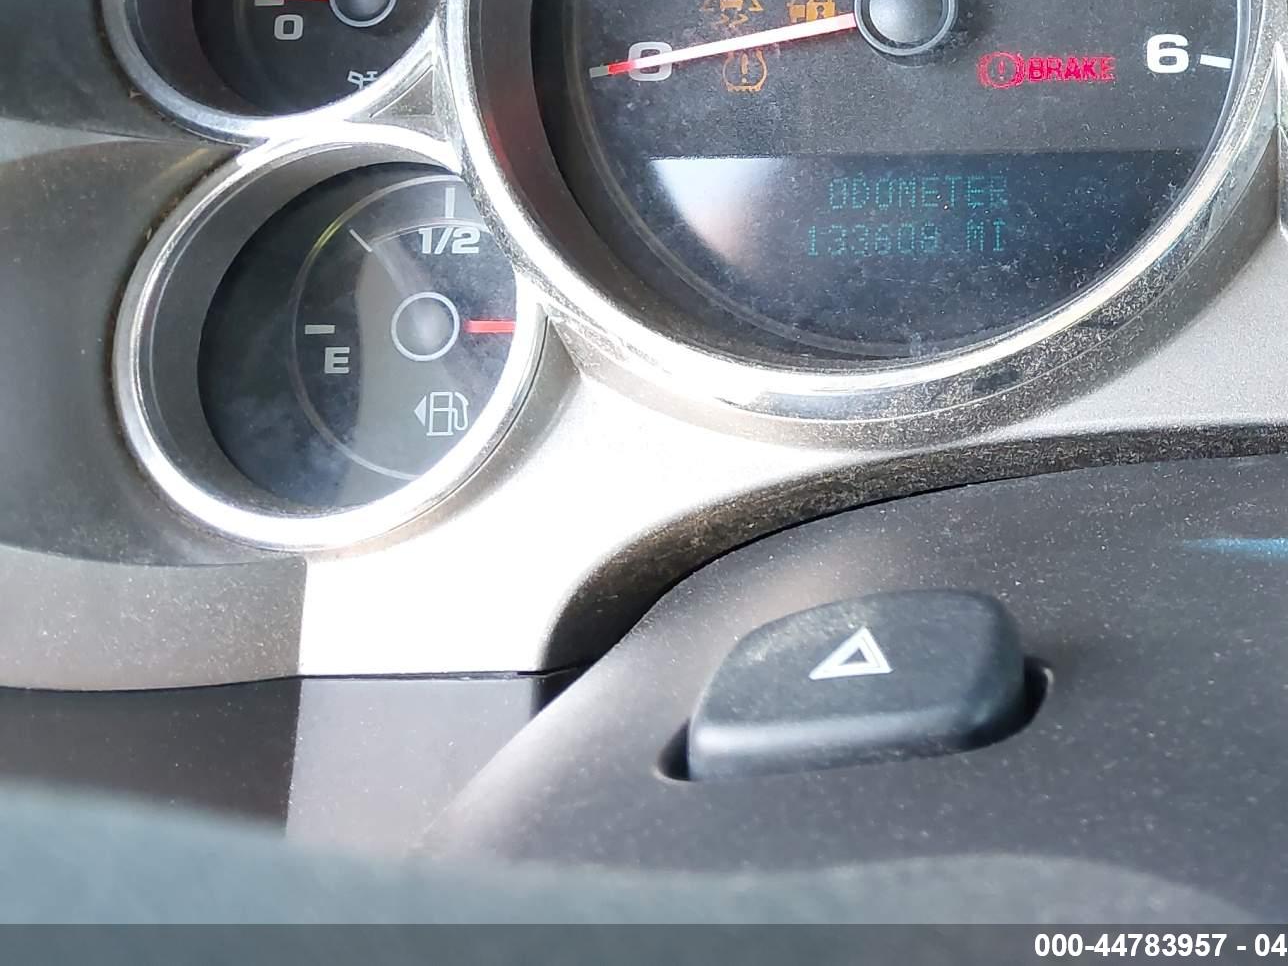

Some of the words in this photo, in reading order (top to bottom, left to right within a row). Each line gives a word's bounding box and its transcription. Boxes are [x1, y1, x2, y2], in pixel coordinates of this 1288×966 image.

[273, 13, 304, 41] 0
[627, 40, 674, 82] 0
[1027, 56, 1117, 82] BRAKE
[1146, 33, 1190, 74] 6
[829, 175, 1008, 210] ODOMETER
[417, 227, 481, 255] 1/2
[965, 217, 1007, 252] MI
[324, 346, 351, 375] E
